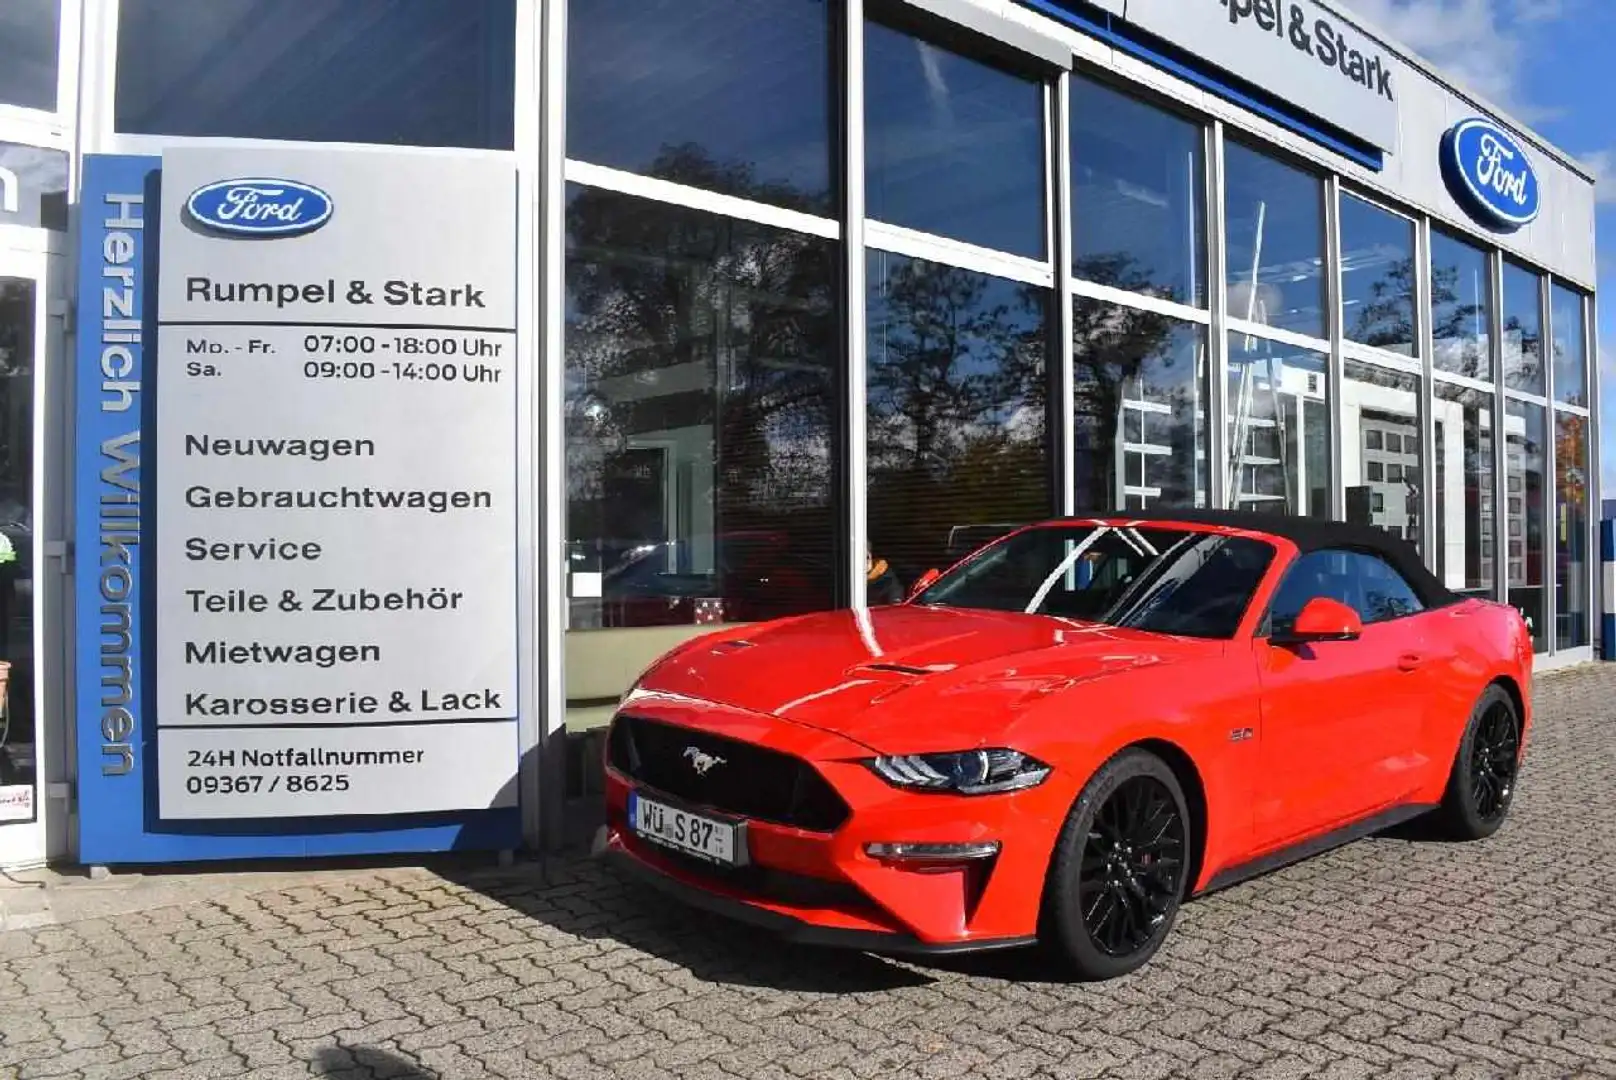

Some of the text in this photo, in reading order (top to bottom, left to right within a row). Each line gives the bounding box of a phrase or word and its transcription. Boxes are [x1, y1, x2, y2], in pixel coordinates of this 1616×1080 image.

[1288, 4, 1315, 56] &
[1313, 19, 1393, 102] Stark
[1477, 133, 1527, 206] Ford
[217, 187, 304, 221] Ford
[186, 277, 486, 309] Rumpel & Stark
[186, 339, 229, 354] Mo.
[248, 339, 276, 354] Fr.
[463, 338, 502, 357] Uhr
[186, 361, 222, 377] Sa.
[463, 364, 501, 383] Uhr
[185, 434, 375, 461] Neuwagen
[100, 193, 144, 776] Herzlich Willkommen
[185, 485, 492, 514] Gebrauchtwagen
[185, 537, 322, 561] Service
[185, 587, 463, 613] Teile & Zubehör
[185, 641, 381, 668] Mietwagen
[185, 688, 501, 716] Karosserie & Lack
[187, 748, 425, 767] 24H Notfallnummer
[186, 775, 264, 794] 09367
[286, 774, 350, 793] 8625
[643, 802, 664, 833] WÜ
[675, 813, 686, 842] S
[690, 819, 713, 850] 87
